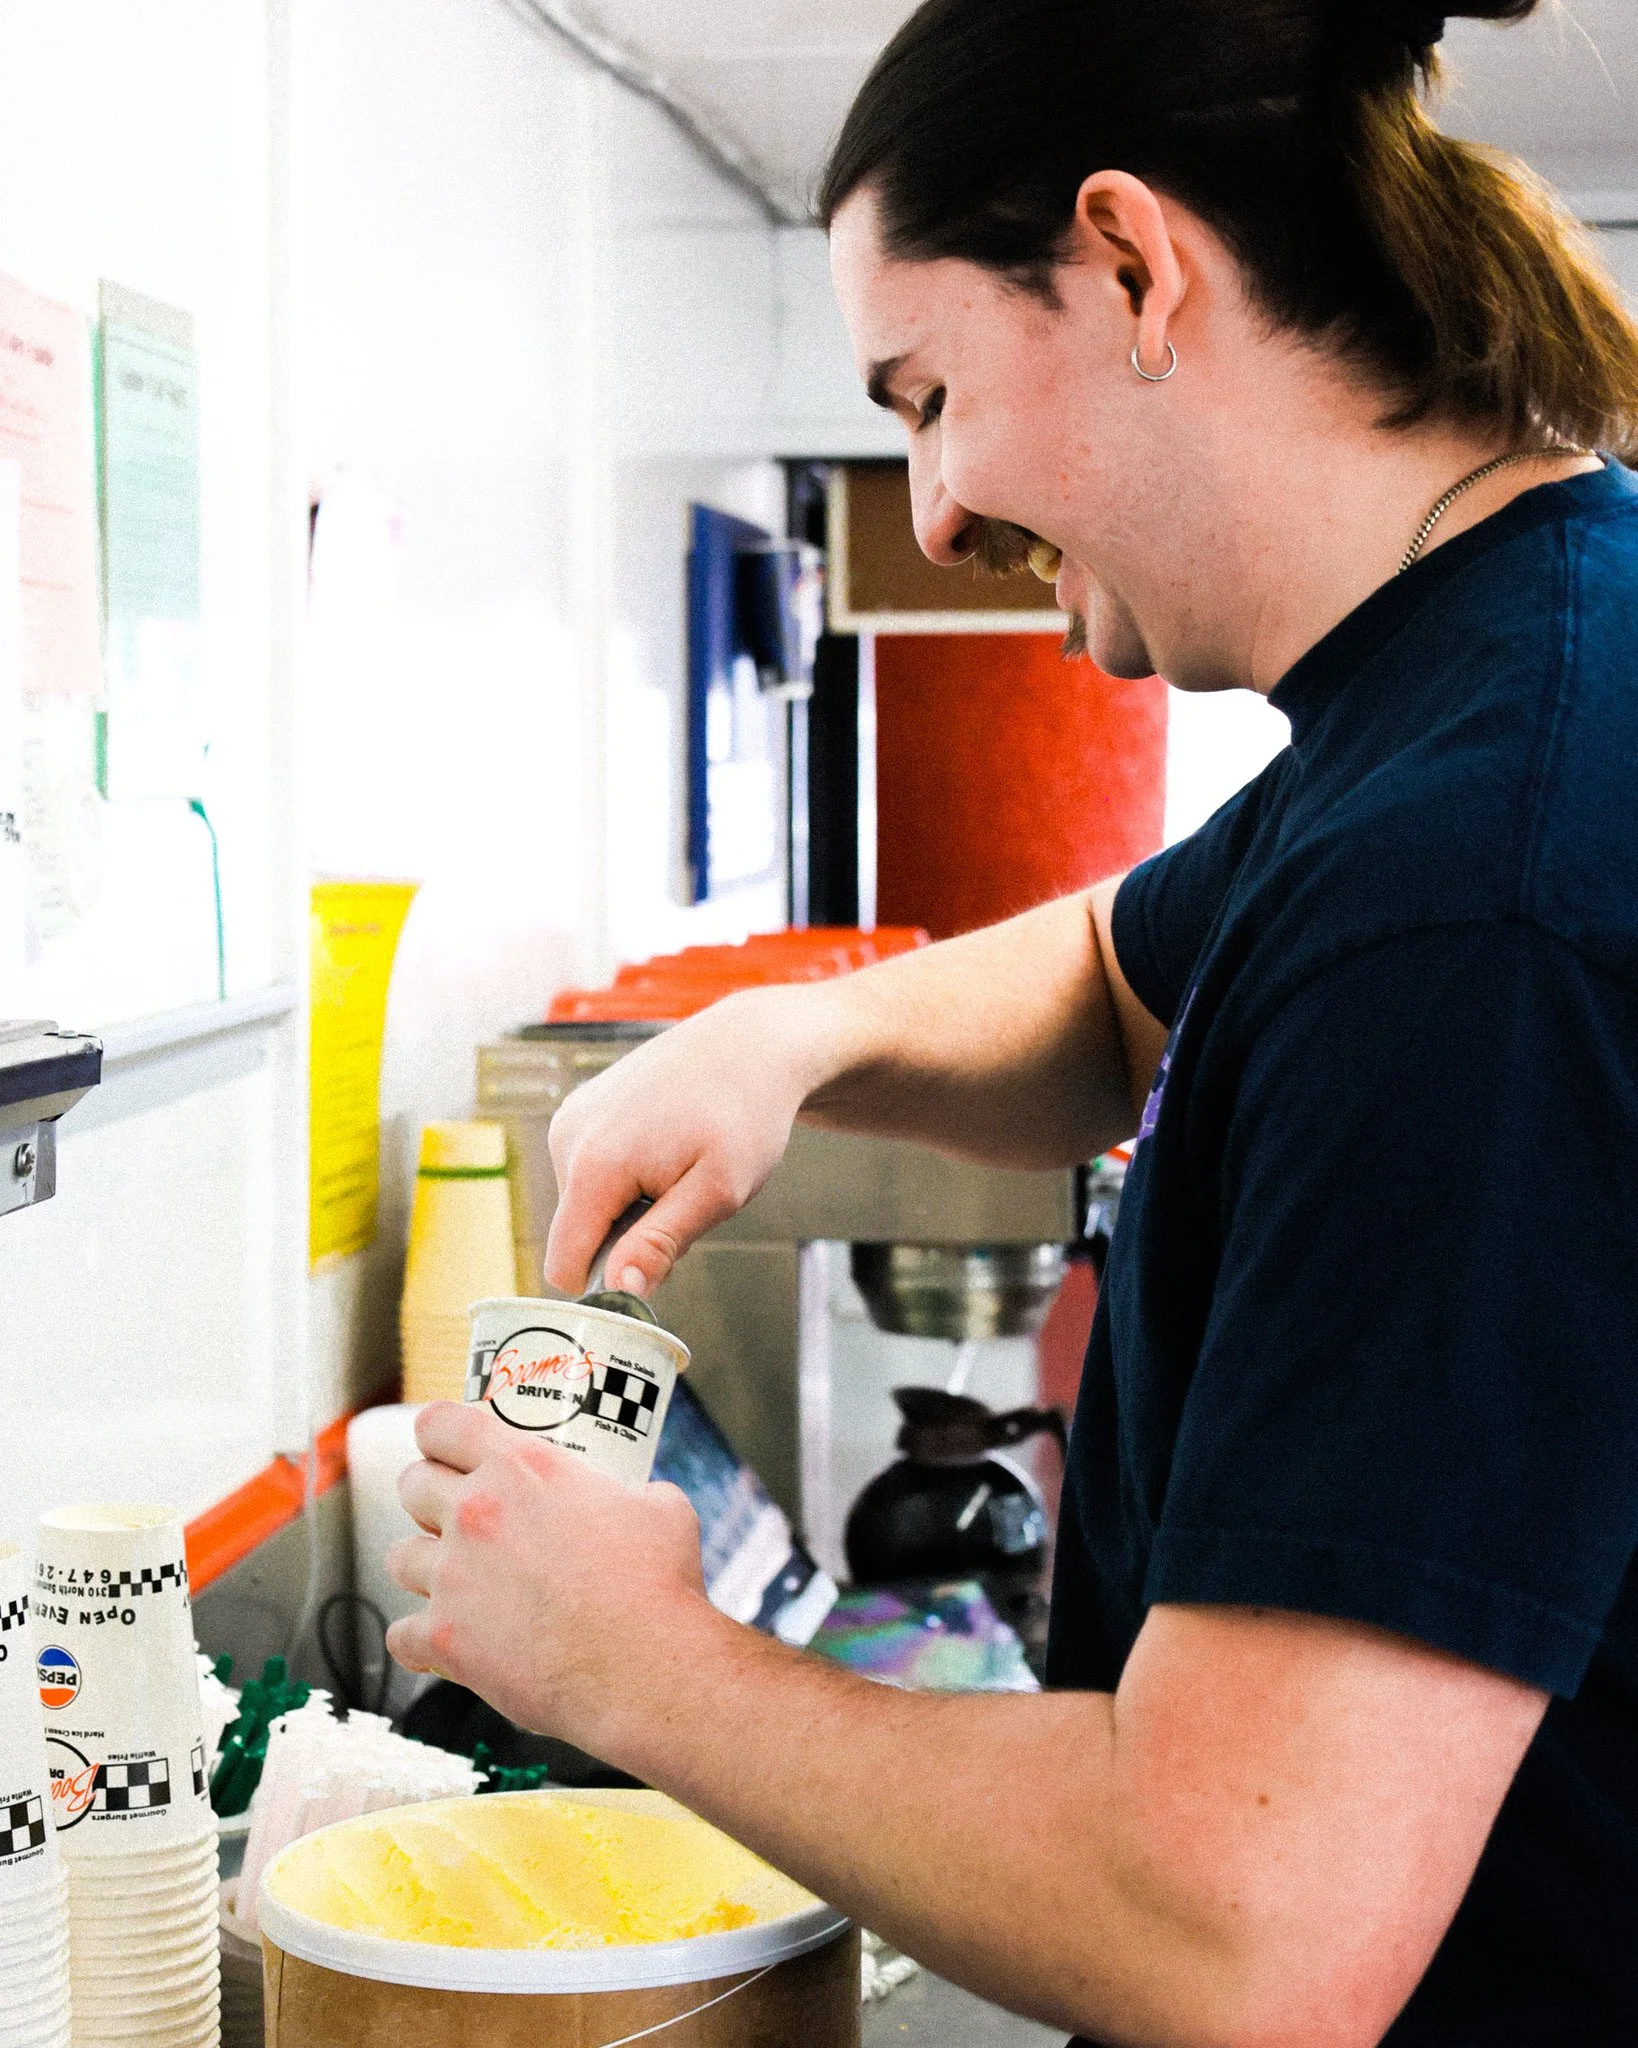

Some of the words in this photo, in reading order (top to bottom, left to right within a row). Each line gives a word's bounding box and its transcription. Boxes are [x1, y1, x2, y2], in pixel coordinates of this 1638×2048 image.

[609, 1354, 633, 1368] Fresh
[594, 1420, 612, 1433] Fish
[620, 1428, 638, 1443] Chips
[58, 1585, 85, 1597] North
[89, 1587, 107, 1597] 310
[48, 1728, 70, 1737] Cream
[71, 1730, 83, 1738] Ice
[84, 1730, 105, 1738] Hard
[107, 1753, 128, 1761] Fries
[130, 1750, 156, 1760] Waffle
[11, 1788, 32, 1801] Waffle
[91, 1812, 128, 1822] Burgers
[129, 1808, 167, 1820] Gourmet
[14, 1848, 44, 1863] Gourmet
